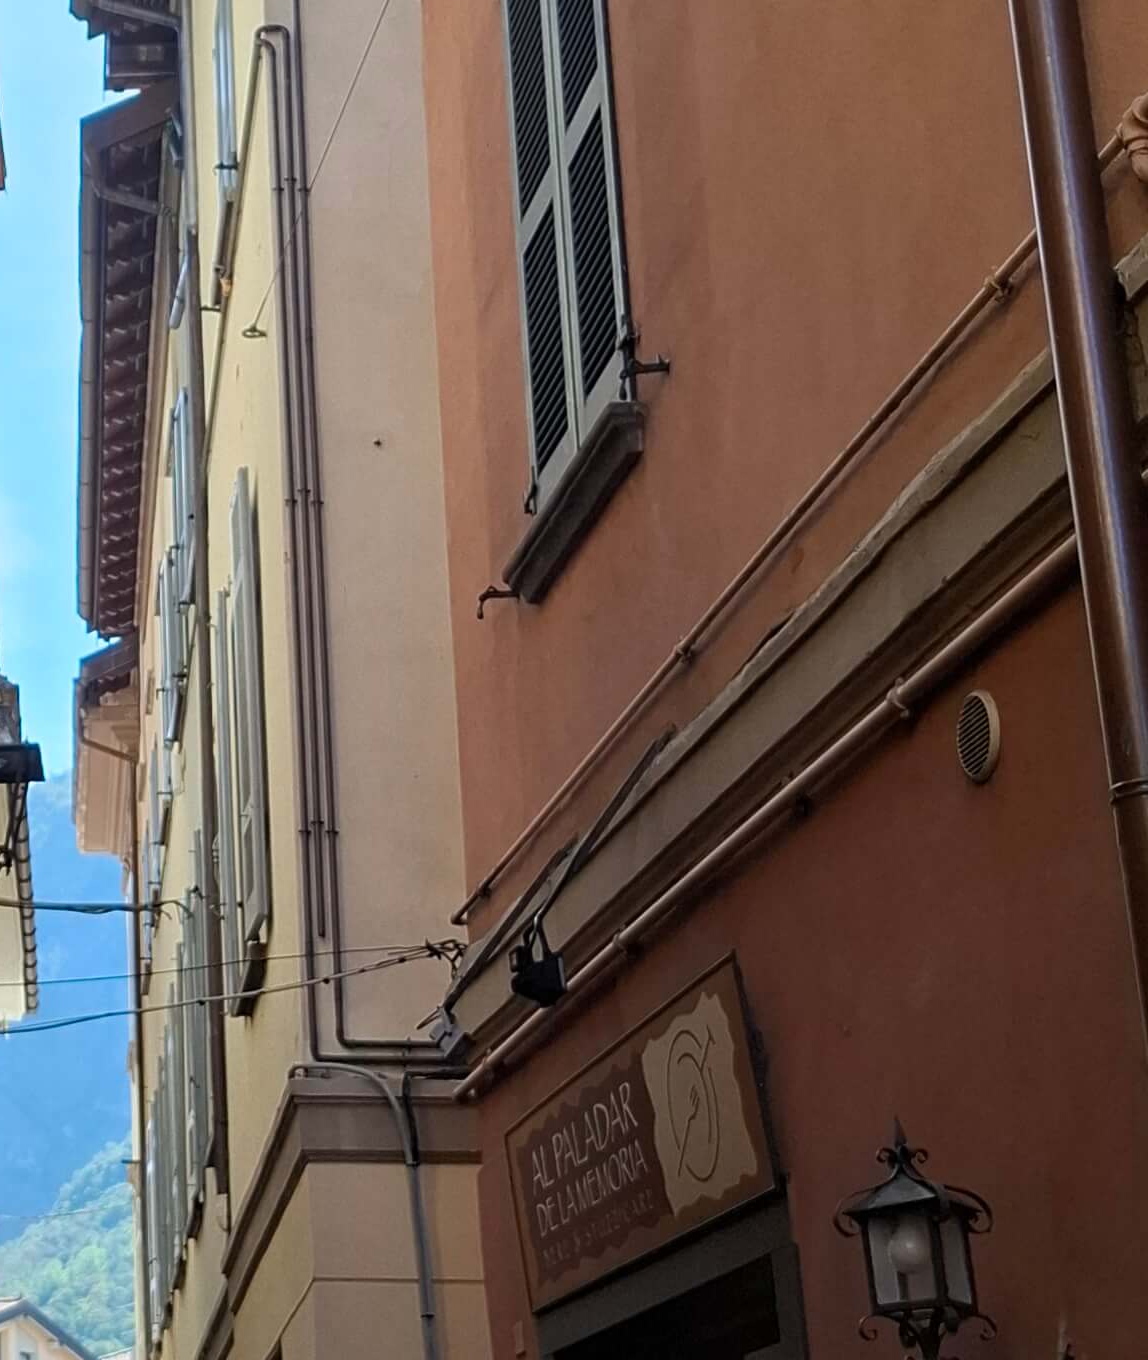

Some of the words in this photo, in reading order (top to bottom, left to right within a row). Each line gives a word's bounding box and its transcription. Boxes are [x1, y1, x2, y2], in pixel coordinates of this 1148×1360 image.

[532, 1144, 554, 1197] AL
[552, 1081, 639, 1180] PALADAR
[536, 1196, 559, 1237] DE
[557, 1183, 579, 1225] LA
[575, 1138, 649, 1213] MEMORIA
